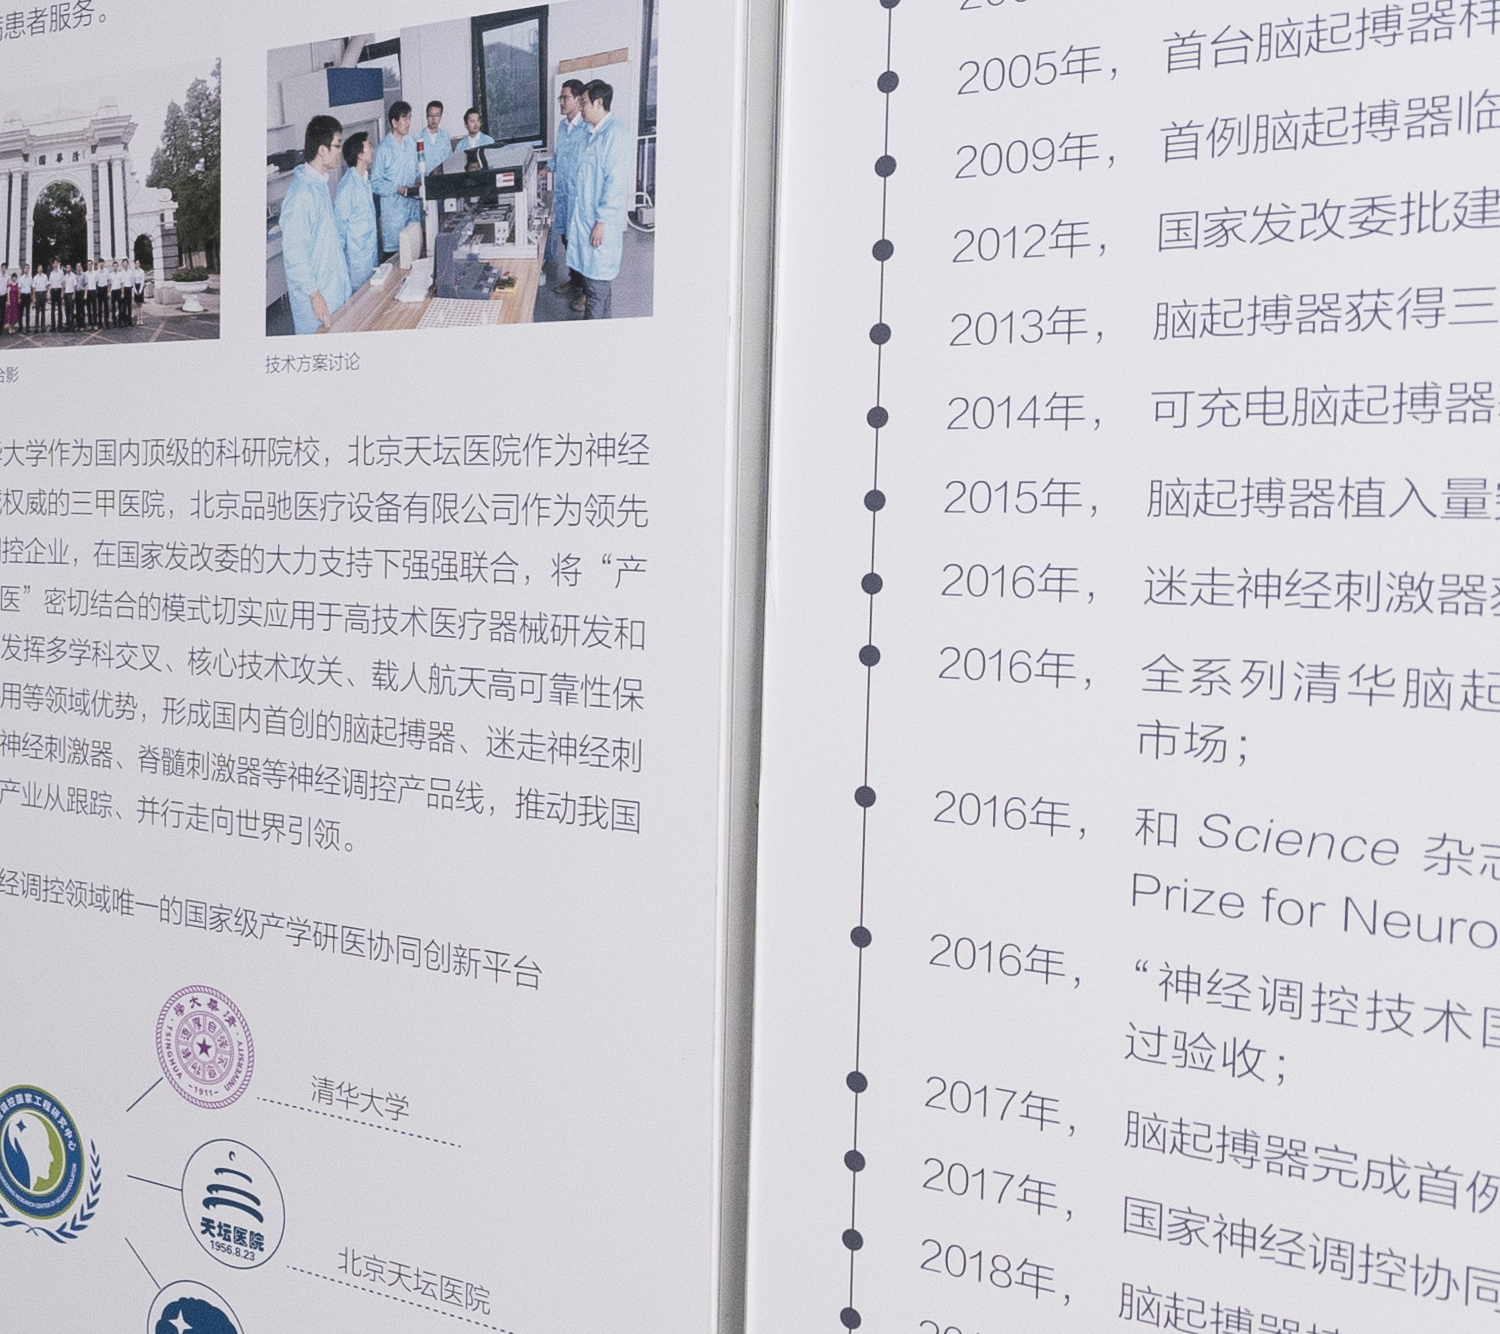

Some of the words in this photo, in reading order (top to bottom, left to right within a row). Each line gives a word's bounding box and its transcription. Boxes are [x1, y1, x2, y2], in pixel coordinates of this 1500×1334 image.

[265, 351, 361, 374] 技术方案讨论
[1150, 380, 1500, 430] 可充电脑起搏器
[1146, 475, 1500, 522] 脑起搏器植入量
[1143, 564, 1500, 618] 迷走神经刺激器
[1136, 718, 1247, 768] 市场；
[1134, 807, 1179, 849] 和
[1197, 812, 1400, 867] Science
[1131, 872, 1246, 920] Prize
[1260, 886, 1327, 929] for
[165, 1025, 183, 1080] TSINGHUA
[223, 1040, 244, 1092] UNIVERSITY
[1123, 1021, 1286, 1087] 过验收；
[310, 1074, 410, 1122] 清华大学
[200, 1216, 265, 1252] 天坛医院
[209, 1239, 255, 1261] 1956.8.23
[337, 1246, 491, 1316] 北京天坛医院
